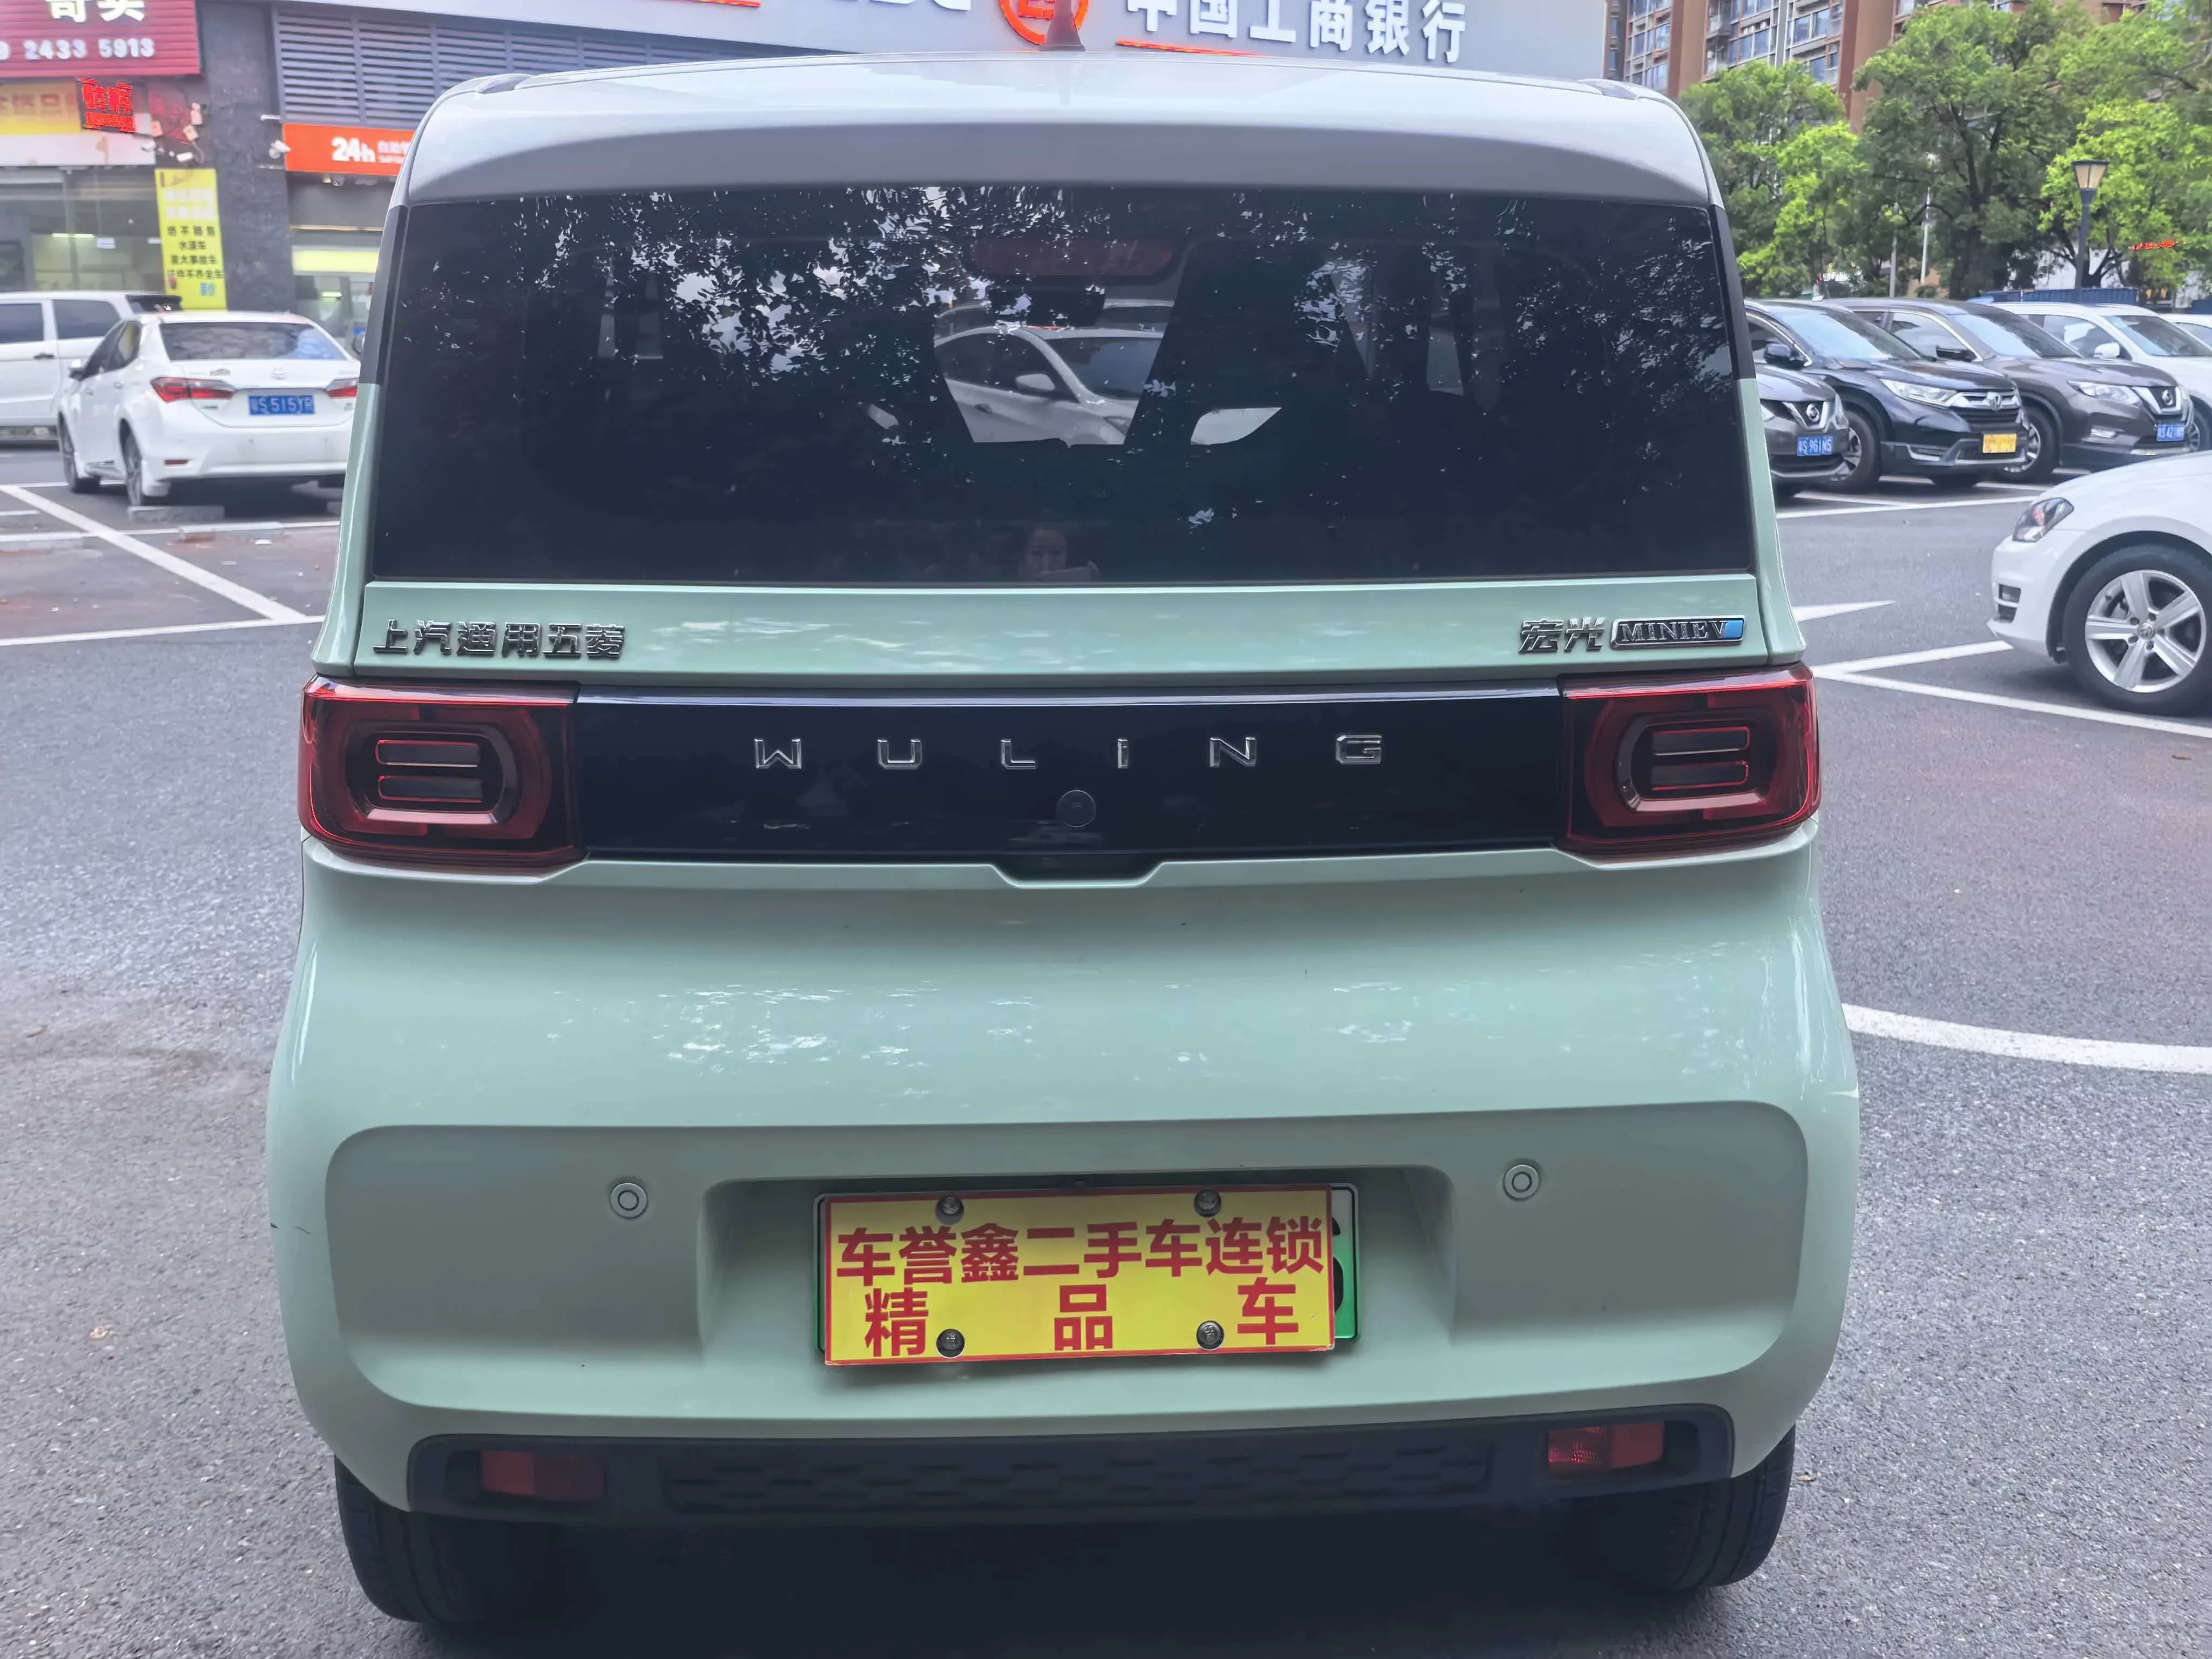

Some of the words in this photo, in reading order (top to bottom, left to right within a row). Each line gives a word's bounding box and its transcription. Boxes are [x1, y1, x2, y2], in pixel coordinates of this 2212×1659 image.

[98, 38, 154, 58] 5913
[331, 136, 376, 163] 24h
[373, 617, 625, 660] 上汽通用五菱
[1519, 616, 1606, 653] 宏光
[1620, 621, 1728, 642] MINIEV
[754, 734, 1382, 770] WULING
[835, 1216, 1324, 1286] 车誉鑫二手车连锁
[865, 1277, 1299, 1358] 精品车
